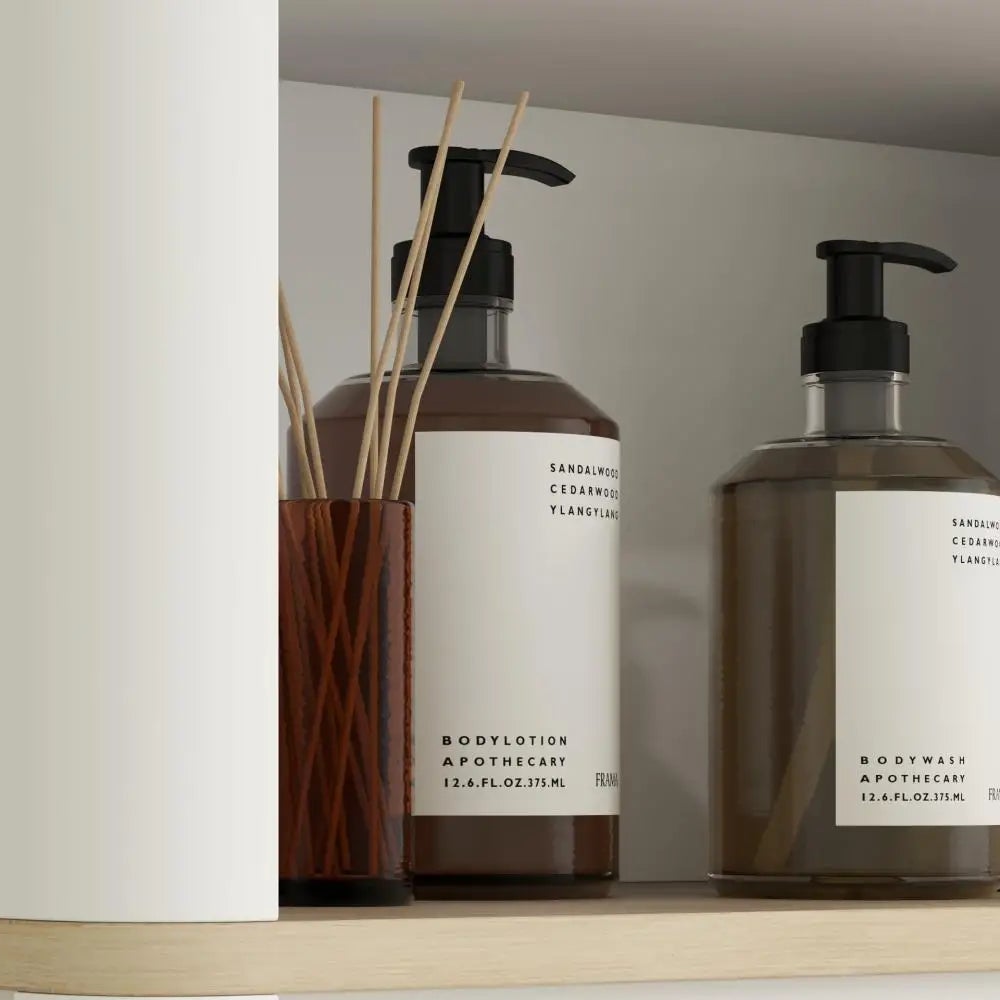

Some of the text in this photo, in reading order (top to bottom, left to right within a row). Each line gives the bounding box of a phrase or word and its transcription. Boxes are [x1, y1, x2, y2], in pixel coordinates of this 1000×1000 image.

[952, 536, 1000, 548] CEDARWO
[442, 735, 567, 746] BODYLOTION
[442, 756, 566, 767] APOTHECARY
[860, 756, 965, 765] BODYWASH
[444, 777, 566, 788] 12.6.FL.OZ.375.ML
[860, 774, 965, 783] APOTHECARY
[861, 792, 965, 802] 12.6.FL.OZ.375.ML
